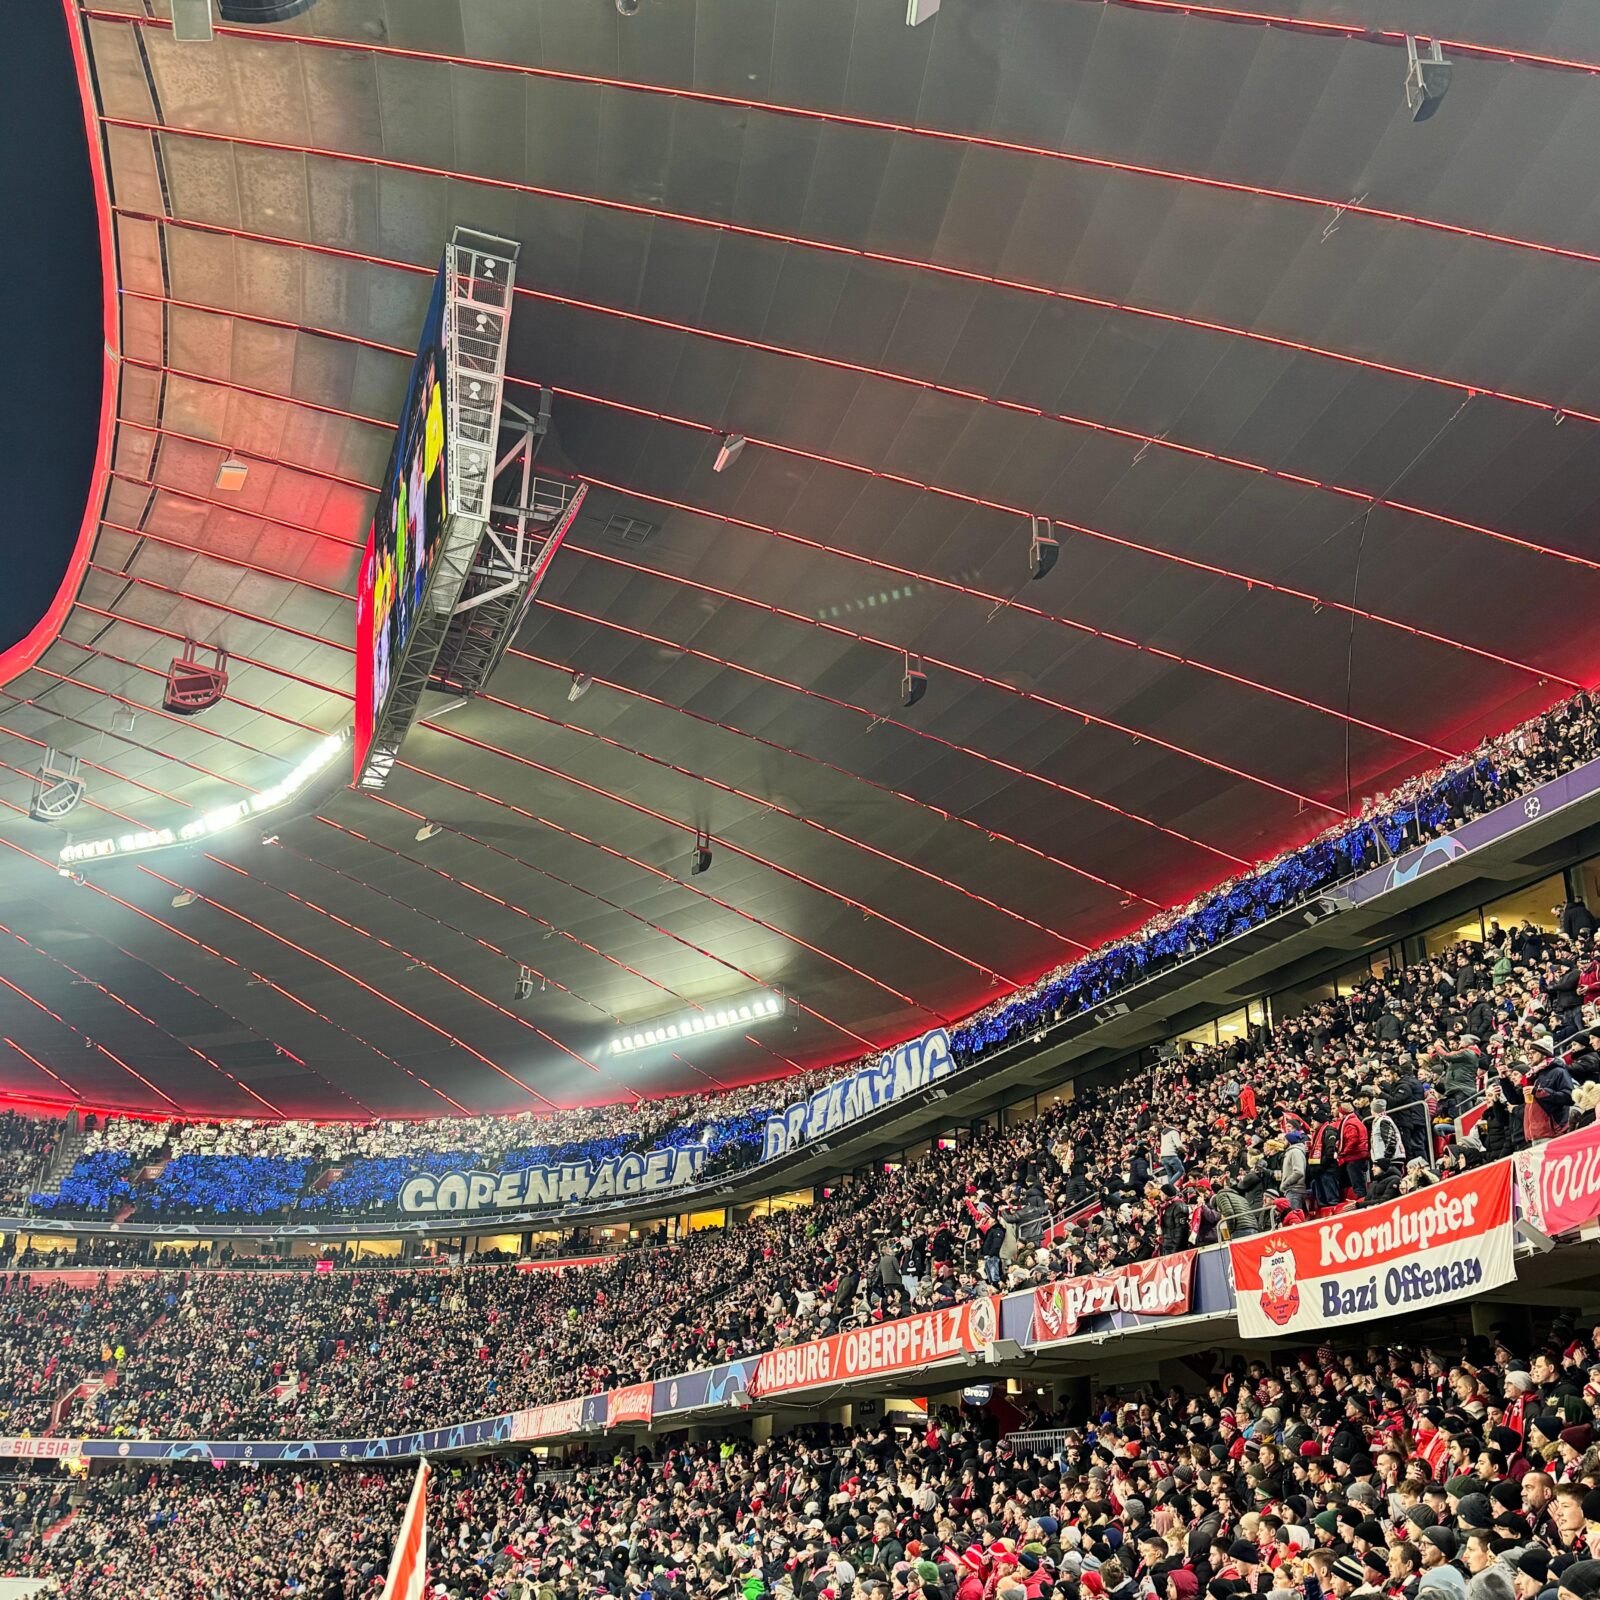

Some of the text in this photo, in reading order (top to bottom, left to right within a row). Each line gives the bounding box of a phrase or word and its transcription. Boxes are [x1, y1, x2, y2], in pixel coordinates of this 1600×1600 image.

[399, 1145, 708, 1212] COPENHAGEN
[1319, 1191, 1479, 1267] Kornlupfer
[1320, 1275, 1379, 1318] Bazi
[757, 1343, 830, 1391] NABBURG
[845, 1306, 963, 1373] OBERPFALZ
[964, 1387, 990, 1398] Breze
[13, 1441, 70, 1456] SILESIA
